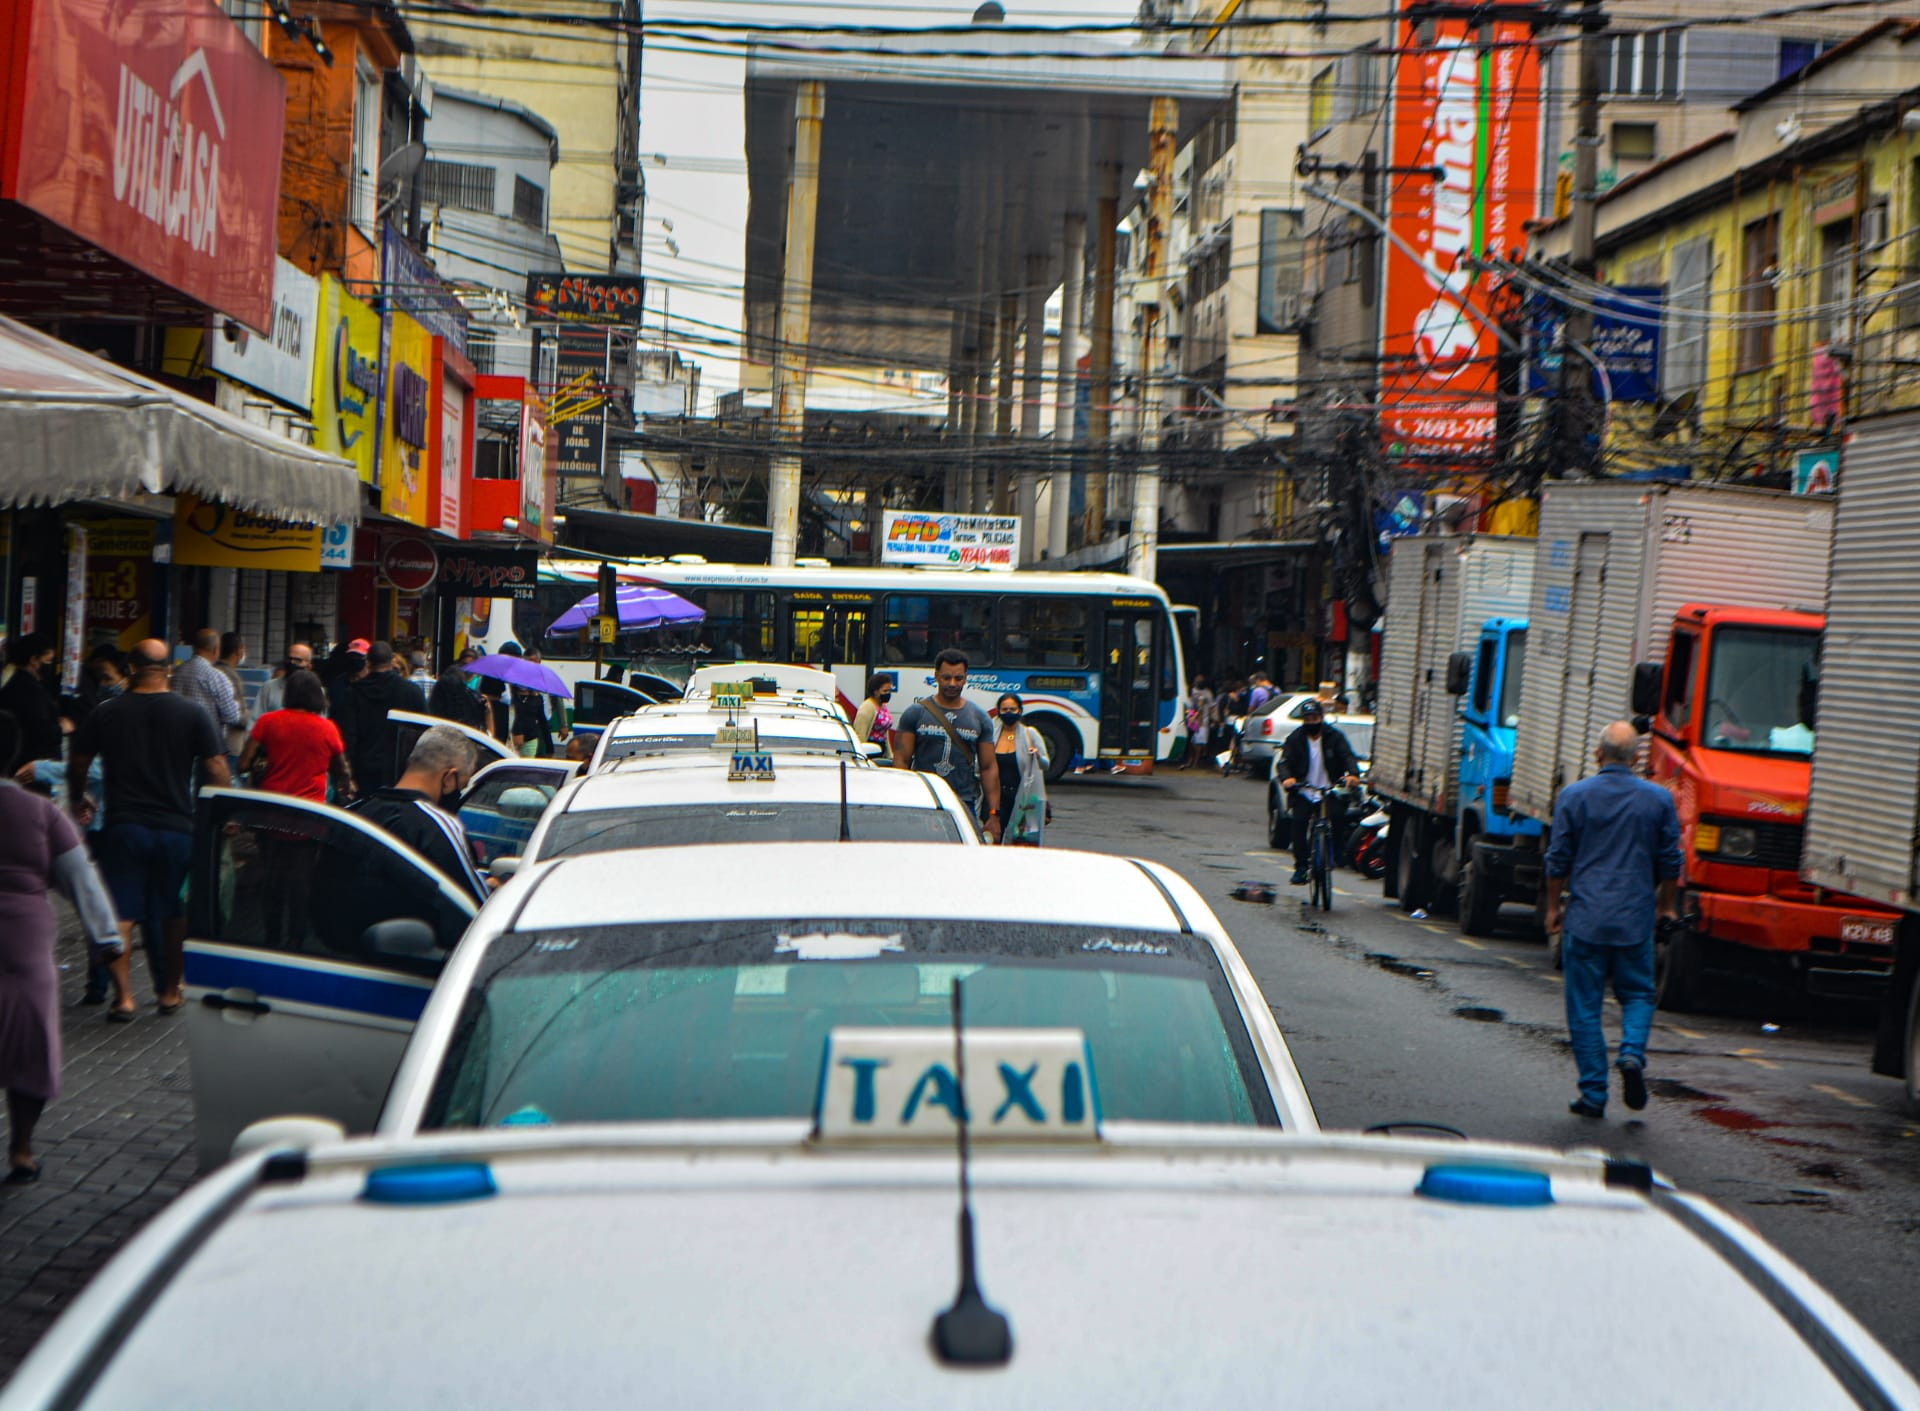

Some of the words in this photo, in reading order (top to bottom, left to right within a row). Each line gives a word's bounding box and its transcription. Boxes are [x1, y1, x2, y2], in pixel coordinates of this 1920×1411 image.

[1491, 121, 1512, 202] FRENTE
[558, 276, 640, 313] Nippo
[888, 519, 941, 542] PFD
[116, 560, 137, 600] 3
[127, 600, 138, 619] 2
[717, 696, 741, 707] TAXI
[732, 755, 773, 772] TAXI
[839, 1056, 1087, 1126] TAXI
